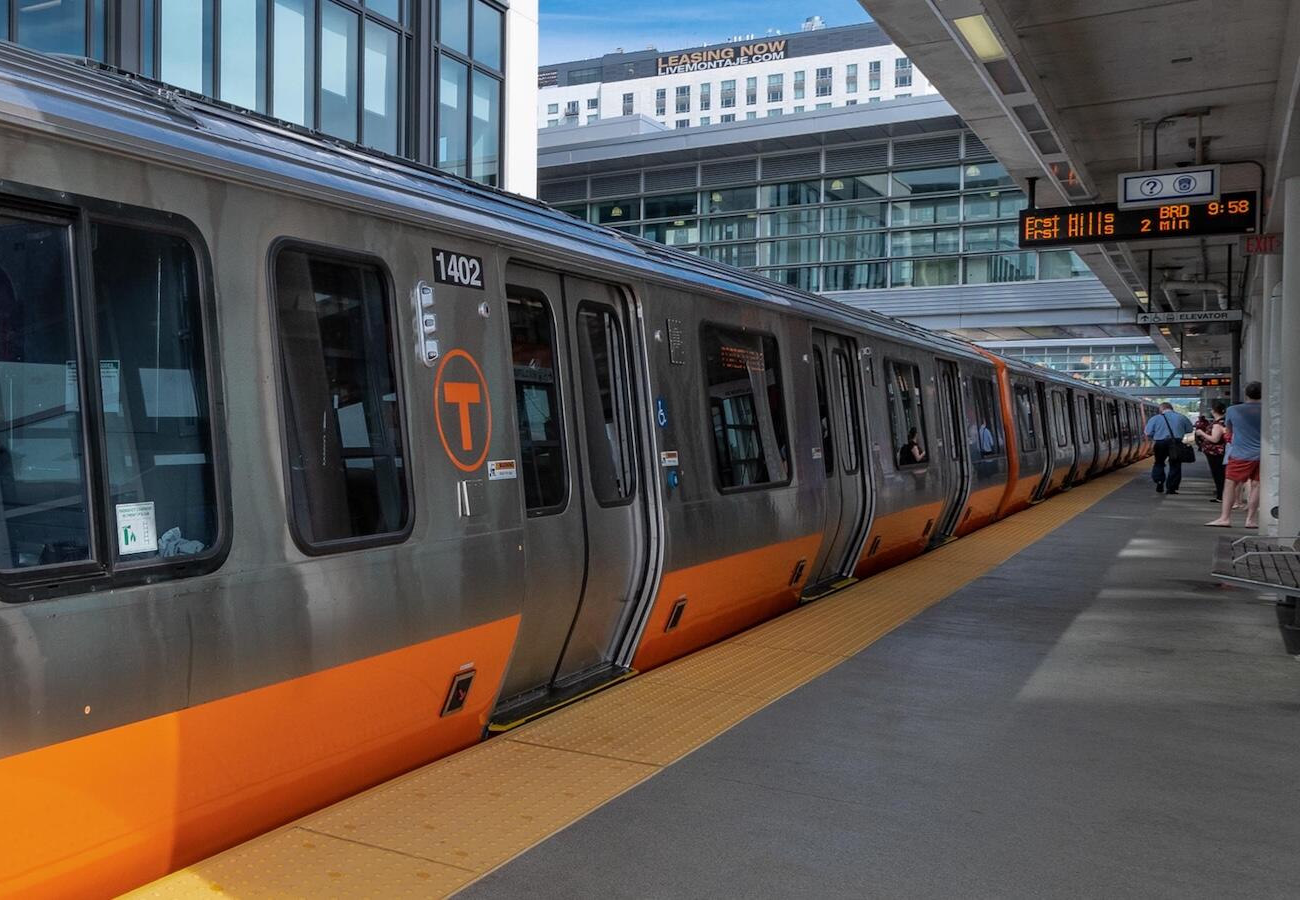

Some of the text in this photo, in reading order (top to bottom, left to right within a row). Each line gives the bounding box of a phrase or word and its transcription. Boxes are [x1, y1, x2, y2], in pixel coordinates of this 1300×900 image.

[657, 40, 786, 68] LEASING NOW
[657, 51, 785, 76] LIVEMONTAJE.COM
[1025, 200, 1249, 229] Frst Hills BRD 9:58
[1025, 217, 1190, 240] Frst Hills 2 min
[1246, 235, 1277, 253] EXIT
[435, 251, 482, 286] 1402
[1179, 312, 1229, 320] ELEVATOR
[443, 382, 481, 451] T
